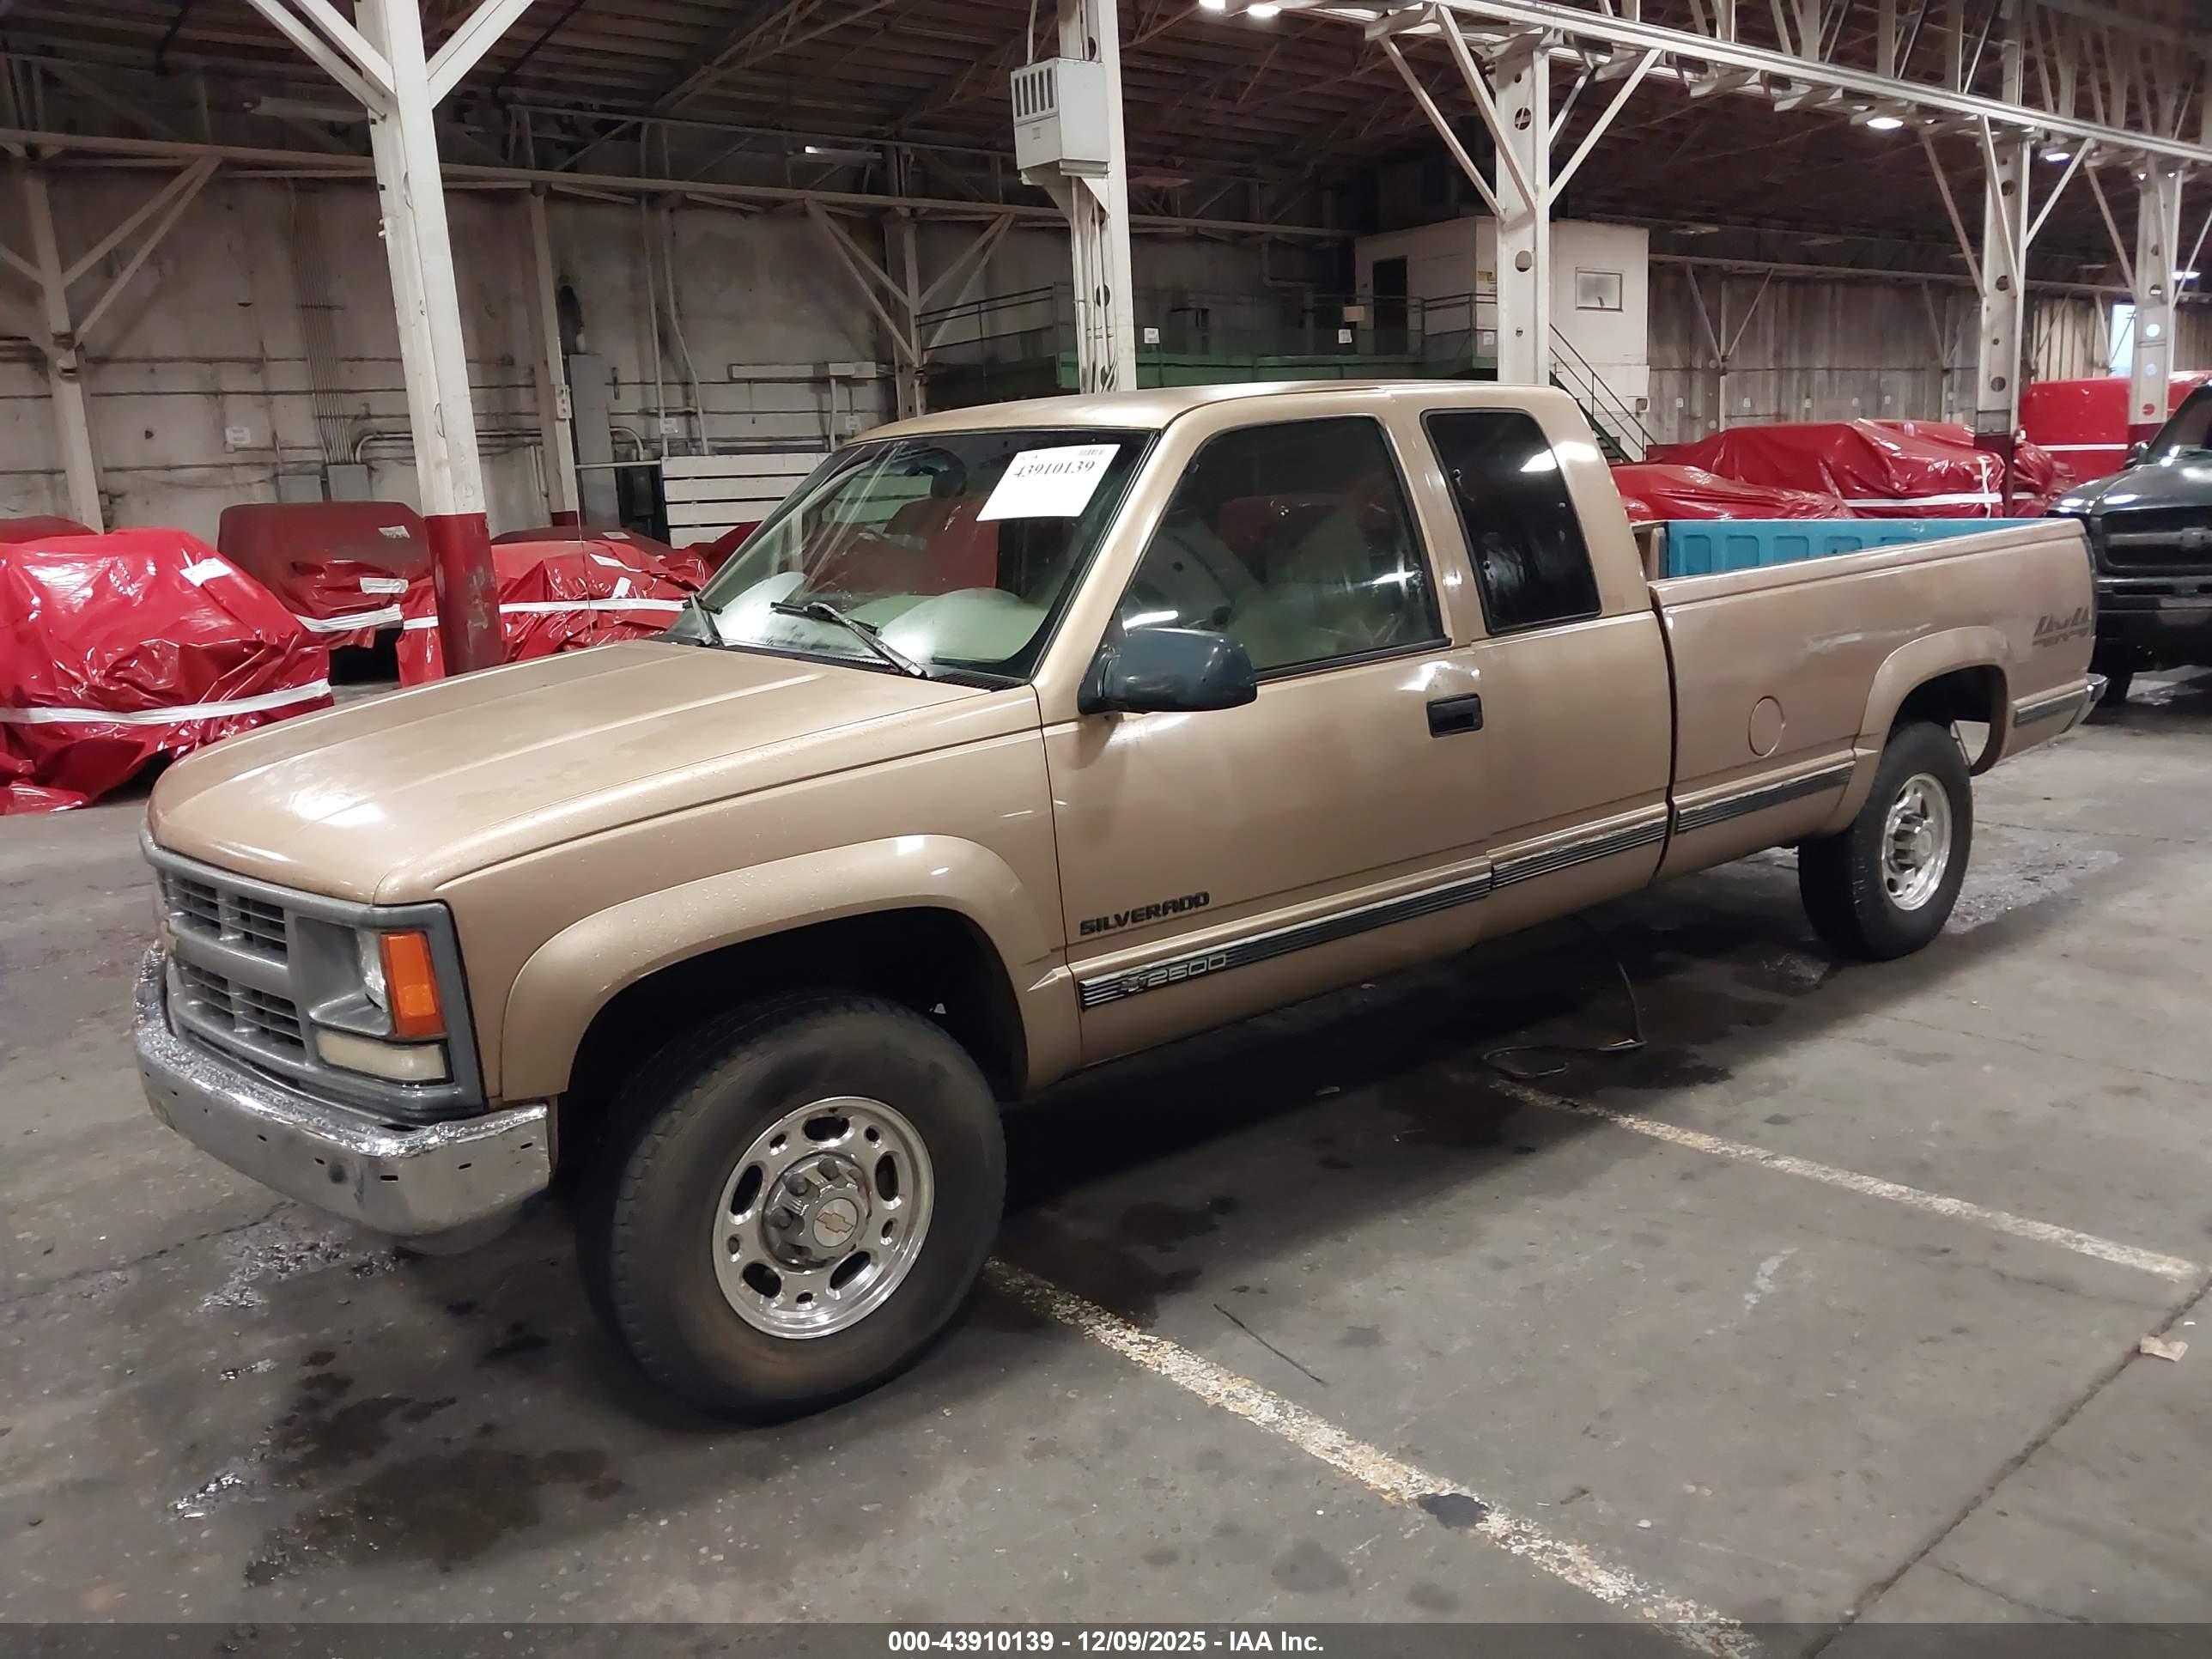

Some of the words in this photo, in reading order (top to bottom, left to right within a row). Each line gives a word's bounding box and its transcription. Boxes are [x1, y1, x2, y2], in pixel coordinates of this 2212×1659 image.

[1014, 460, 1096, 477] 43910139
[1079, 890, 1211, 936] SILVERADO
[1147, 953, 1227, 988] 2500
